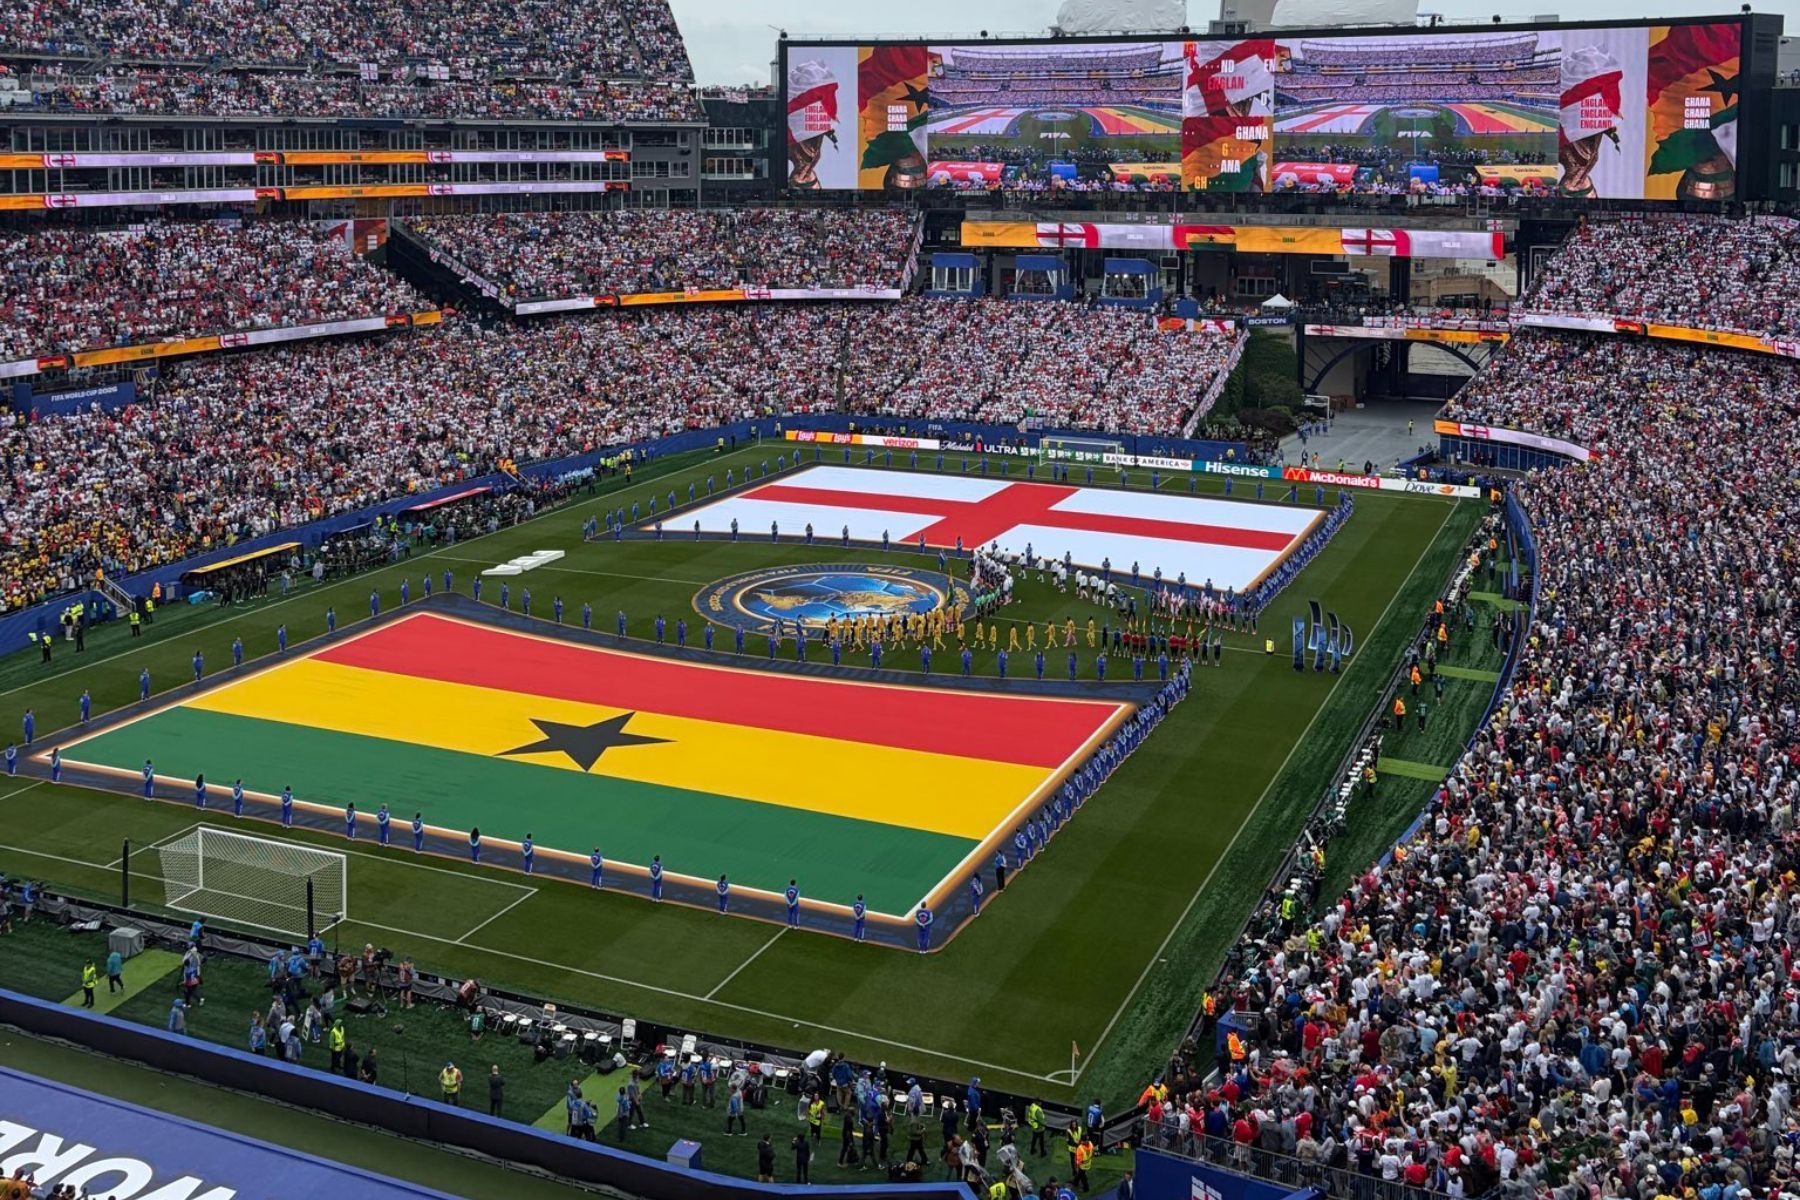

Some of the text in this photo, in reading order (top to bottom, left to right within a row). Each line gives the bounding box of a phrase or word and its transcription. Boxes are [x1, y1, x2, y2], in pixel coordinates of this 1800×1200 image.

[1236, 126, 1269, 140] GHANA
[1221, 160, 1240, 173] ANA
[1194, 176, 1208, 190] GH
[64, 391, 85, 400] WORLD
[86, 389, 98, 397] CUP
[883, 438, 919, 448] verizon
[984, 444, 1018, 455] ULTRA
[1105, 455, 1128, 463] BANK
[1142, 458, 1180, 467] AMERICA
[1205, 461, 1269, 478] Hisense
[1309, 472, 1377, 488] McDonald's
[1404, 482, 1435, 494] Dove
